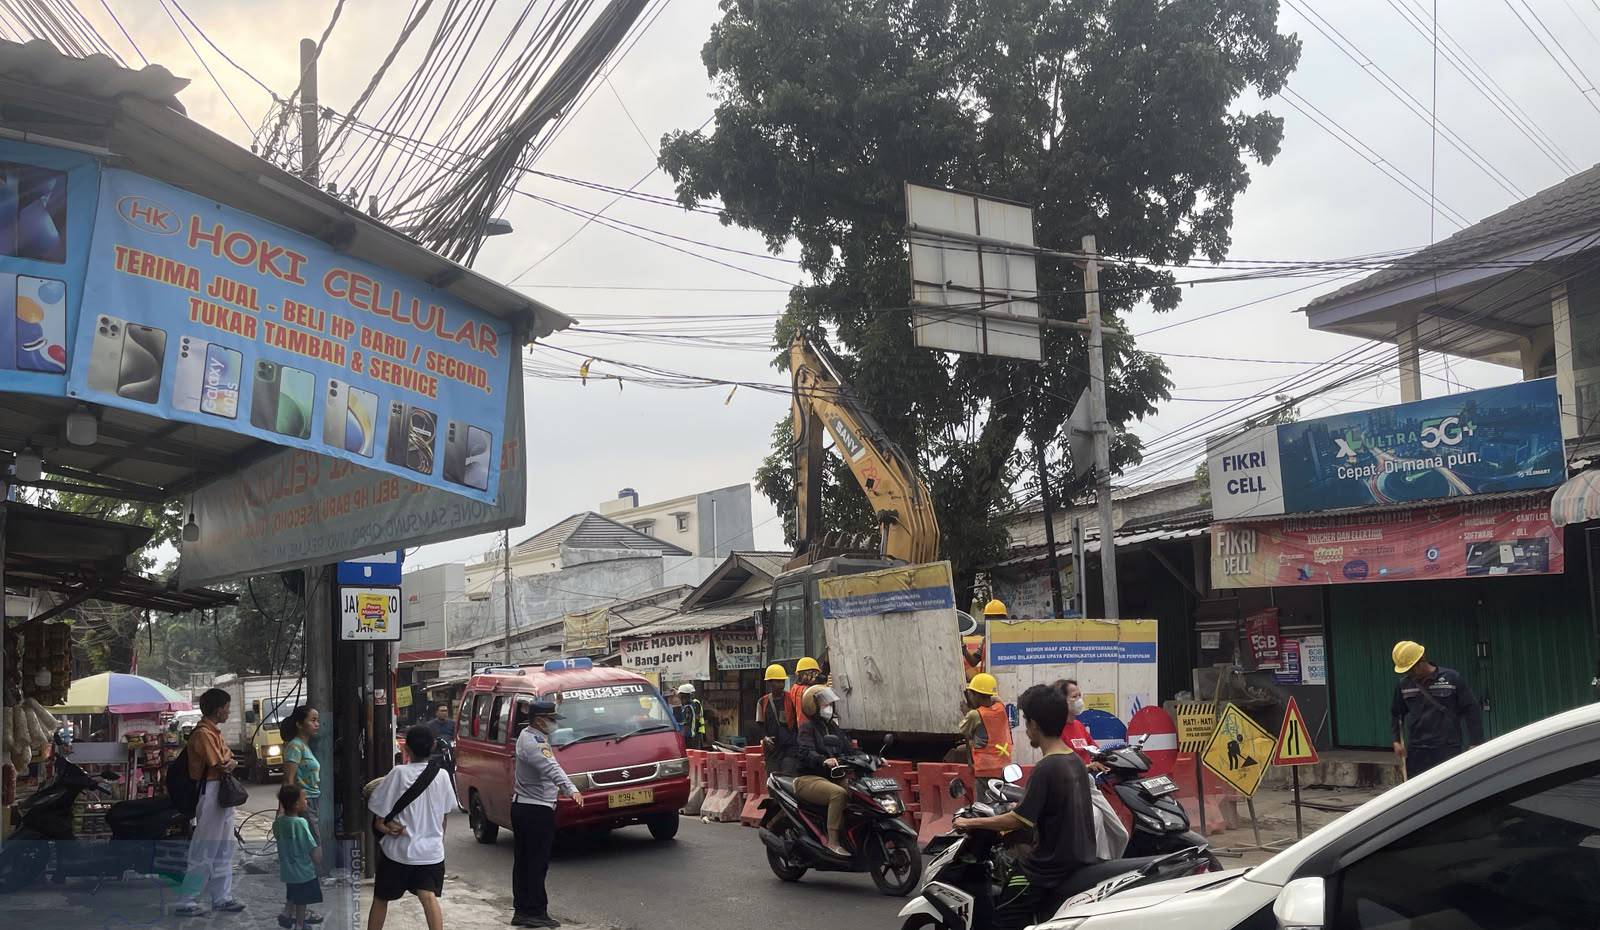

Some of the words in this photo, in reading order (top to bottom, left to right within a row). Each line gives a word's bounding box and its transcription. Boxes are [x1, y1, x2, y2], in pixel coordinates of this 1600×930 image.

[130, 200, 170, 230] HK
[188, 215, 308, 286] HOKI
[323, 268, 498, 356] CELLULAR
[114, 246, 200, 291] TERIMA
[207, 274, 260, 312] JUAL
[283, 303, 325, 331] BELI
[331, 315, 356, 341] HP
[361, 325, 407, 361] BARU
[412, 345, 421, 365] /
[425, 347, 493, 395] SECOND,
[189, 297, 257, 340] TUKAR
[264, 319, 346, 367] TAMBAH
[351, 351, 364, 372] &
[369, 356, 438, 399] SERVICE
[835, 420, 858, 453] SANY
[1366, 432, 1418, 449] ULTRA
[1420, 417, 1477, 449] 5G+
[1223, 451, 1266, 472] FIKRI
[1337, 463, 1380, 481] Cepat.
[1385, 460, 1398, 474] Di
[1403, 457, 1443, 471] mana
[1448, 452, 1481, 470] pun.
[1227, 476, 1266, 495] CELL
[1217, 529, 1257, 556] FIKRI
[1224, 556, 1250, 576] CELL
[626, 639, 649, 653] SATE
[651, 634, 702, 649] MADURA
[1251, 634, 1277, 650] 5GB
[1183, 718, 1196, 726] HATI
[1201, 717, 1213, 725] HATI
